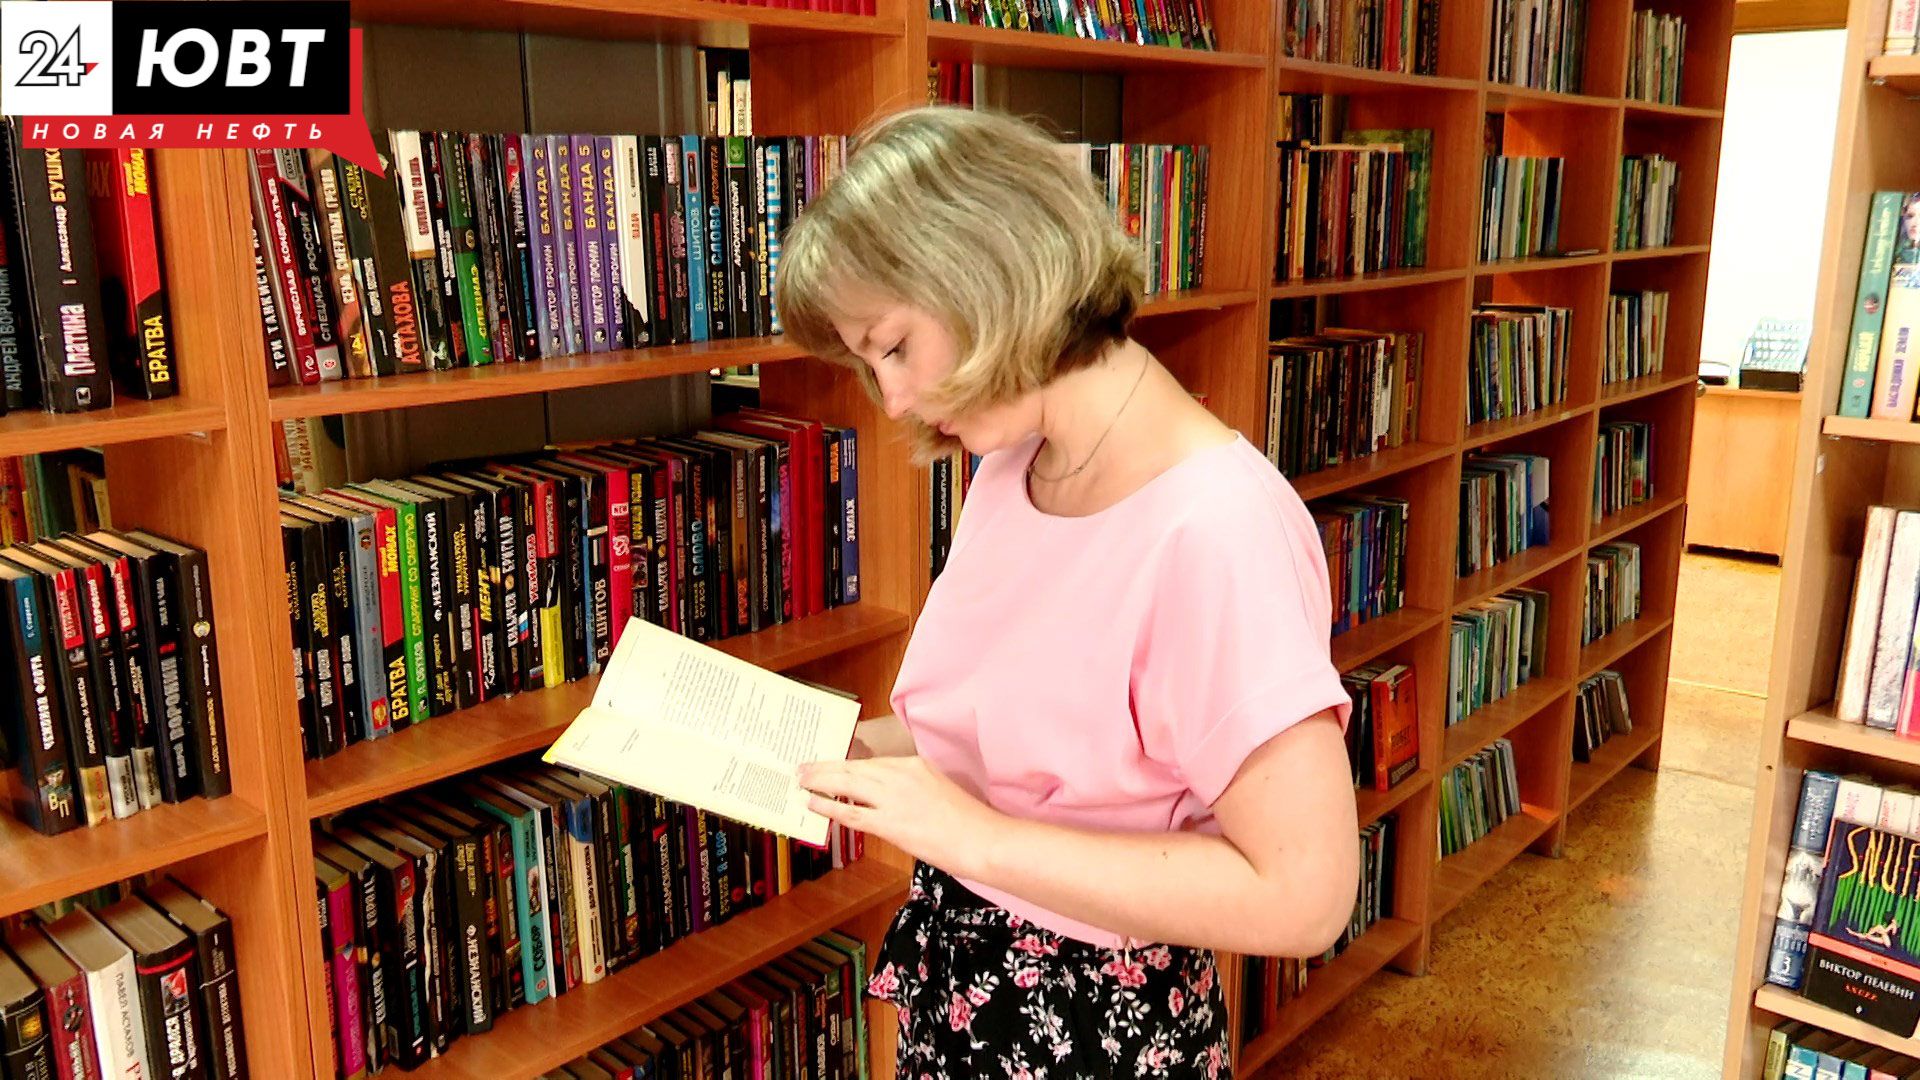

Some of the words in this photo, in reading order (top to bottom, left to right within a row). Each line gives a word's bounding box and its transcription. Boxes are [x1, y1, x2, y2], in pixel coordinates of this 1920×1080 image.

[534, 147, 545, 160] 2
[557, 144, 568, 156] 3
[579, 144, 592, 156] 5
[601, 147, 611, 159] 6
[534, 165, 551, 235] БАНДА
[558, 162, 574, 231] БАНДА
[580, 162, 597, 230] БАНДА
[602, 165, 616, 230] БАНДА
[267, 177, 291, 264] КОНДРАТЬЕВ
[299, 210, 318, 271] РОССИИ
[690, 207, 702, 261] ШИТОВ
[709, 205, 722, 265] СЛОВО
[543, 244, 556, 288] ПРОНИН
[566, 241, 578, 285] ПРОНИН
[587, 241, 602, 283] ПРОНИН
[608, 242, 621, 284] ПРОНИН
[311, 276, 332, 342] СПЕЦНАЗ
[544, 290, 559, 331] ВИКТОР
[568, 286, 581, 327] ВИКТОР
[590, 285, 605, 325] ВИКТОР
[611, 285, 624, 325] ВИКТОР
[717, 271, 725, 312] СУХОВ
[60, 303, 95, 376] Платина
[390, 281, 421, 363] АСТАХОВА
[143, 315, 169, 383] БРАТВА
[269, 340, 287, 369] ТРИ
[404, 513, 416, 566] СМЕРТЬЮ
[691, 520, 704, 576] СЛОВО
[407, 567, 418, 581] СО
[477, 568, 492, 622] МЕНТ
[594, 578, 608, 638] ШИТОВ
[698, 580, 706, 619] СУХОВ
[597, 641, 609, 658] В.
[161, 656, 184, 741] ВОРОНИН
[387, 655, 410, 720] БРАТВА
[1839, 825, 1920, 902] SNUF
[530, 925, 546, 972] СОБОР
[116, 972, 129, 1007] ПАВЕЛ
[1819, 959, 1862, 980] ВИКТОР
[1863, 975, 1915, 1000] ПЕЛЕВИН
[121, 1009, 134, 1058] АСТАХОВ
